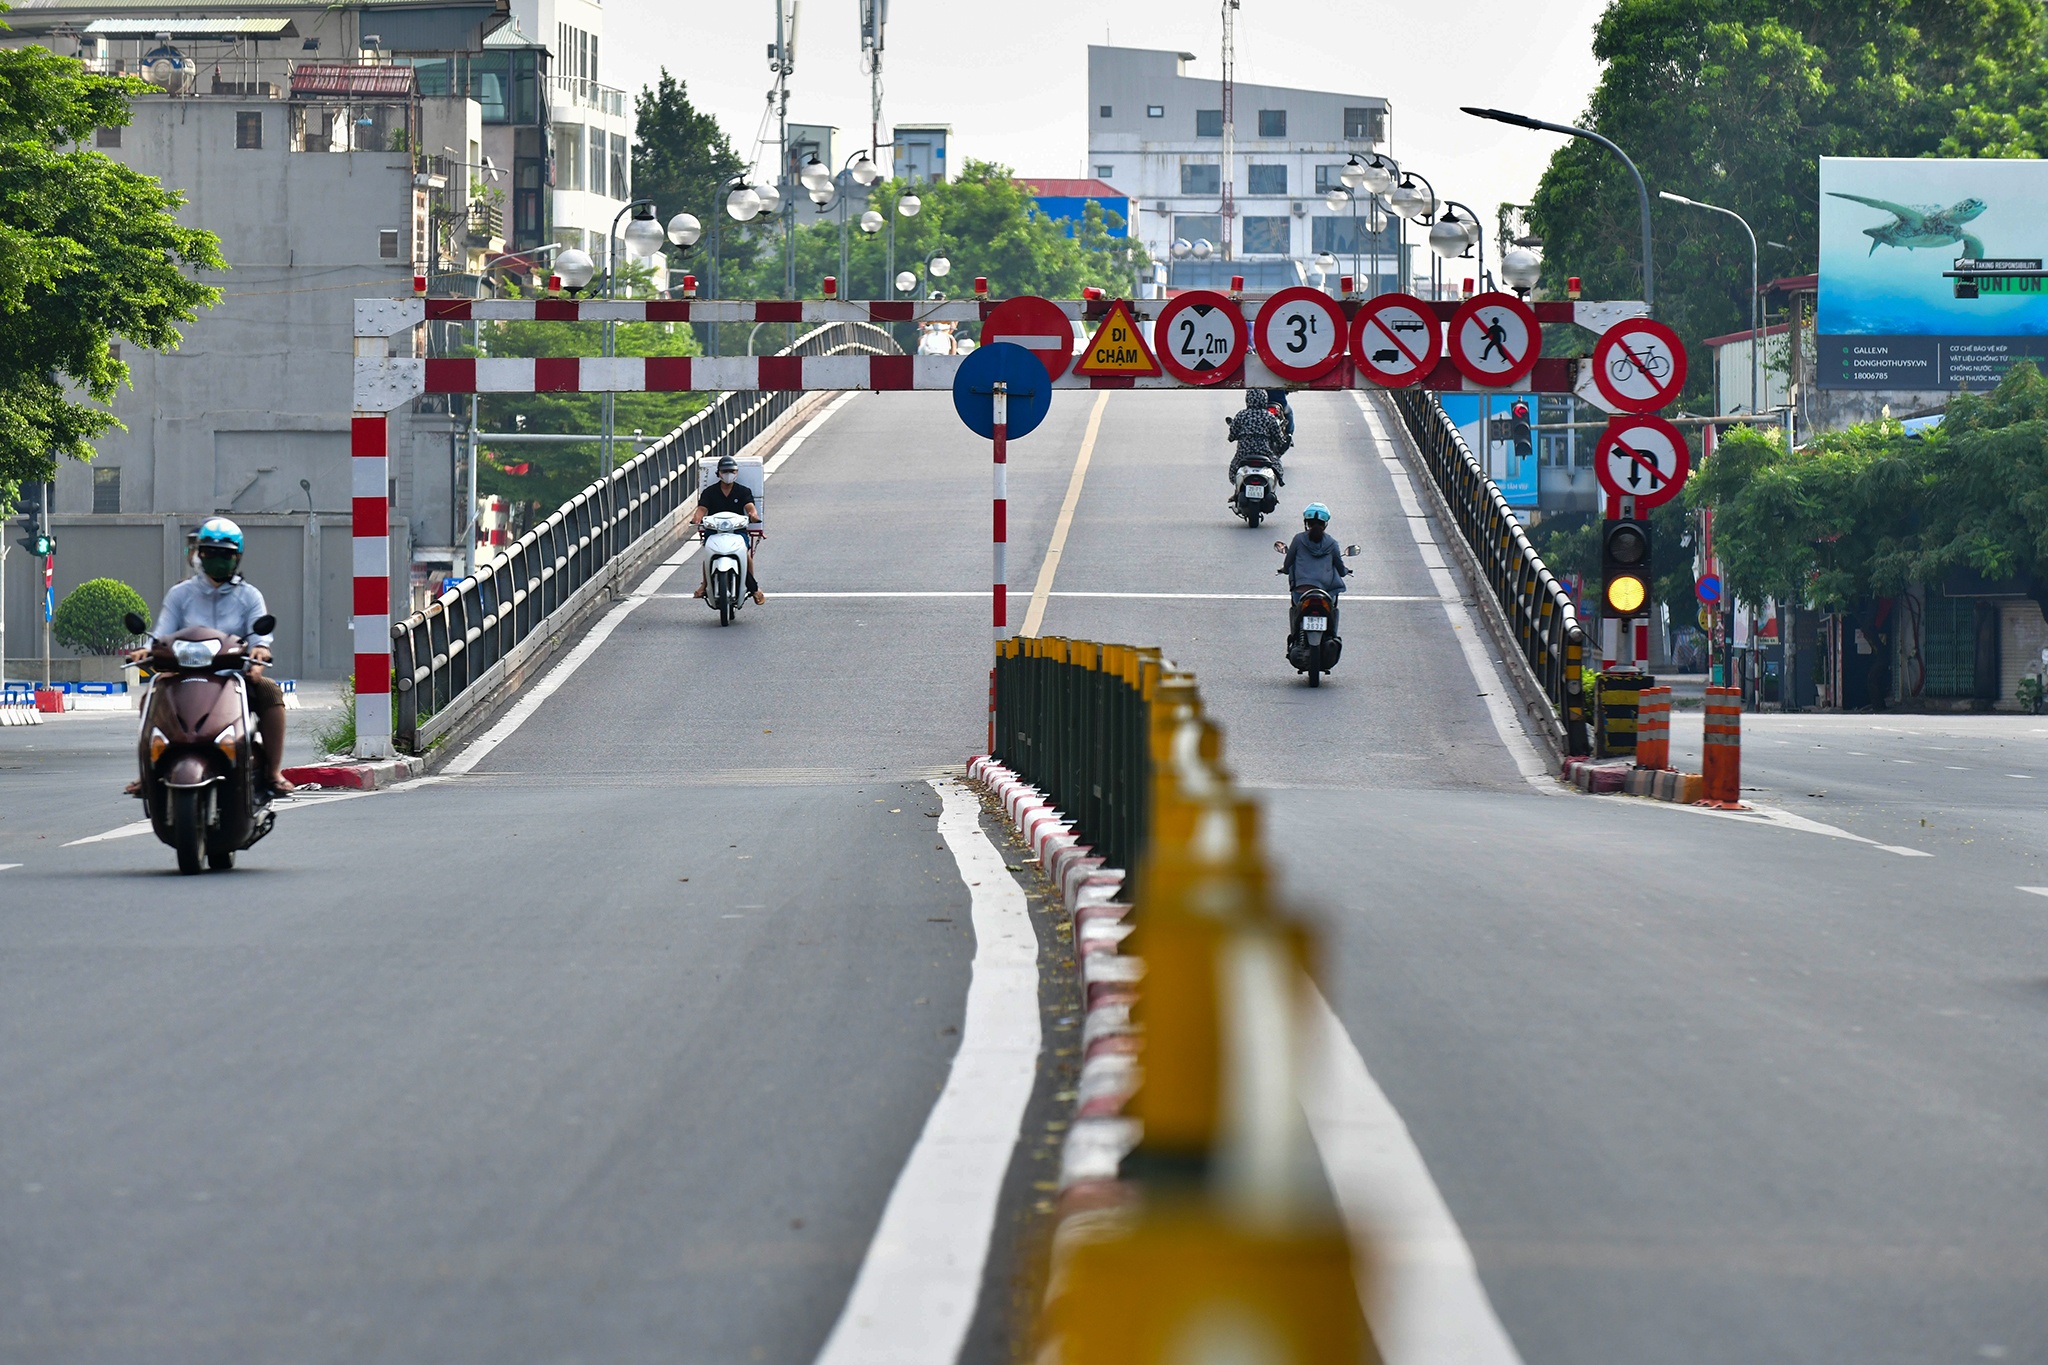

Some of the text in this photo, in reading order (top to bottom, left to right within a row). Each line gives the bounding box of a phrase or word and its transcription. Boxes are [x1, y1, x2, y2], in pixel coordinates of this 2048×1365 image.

[1976, 261, 1994, 269] TAKING
[1112, 328, 1126, 342] ĐI
[1096, 345, 1138, 366] CHẬM
